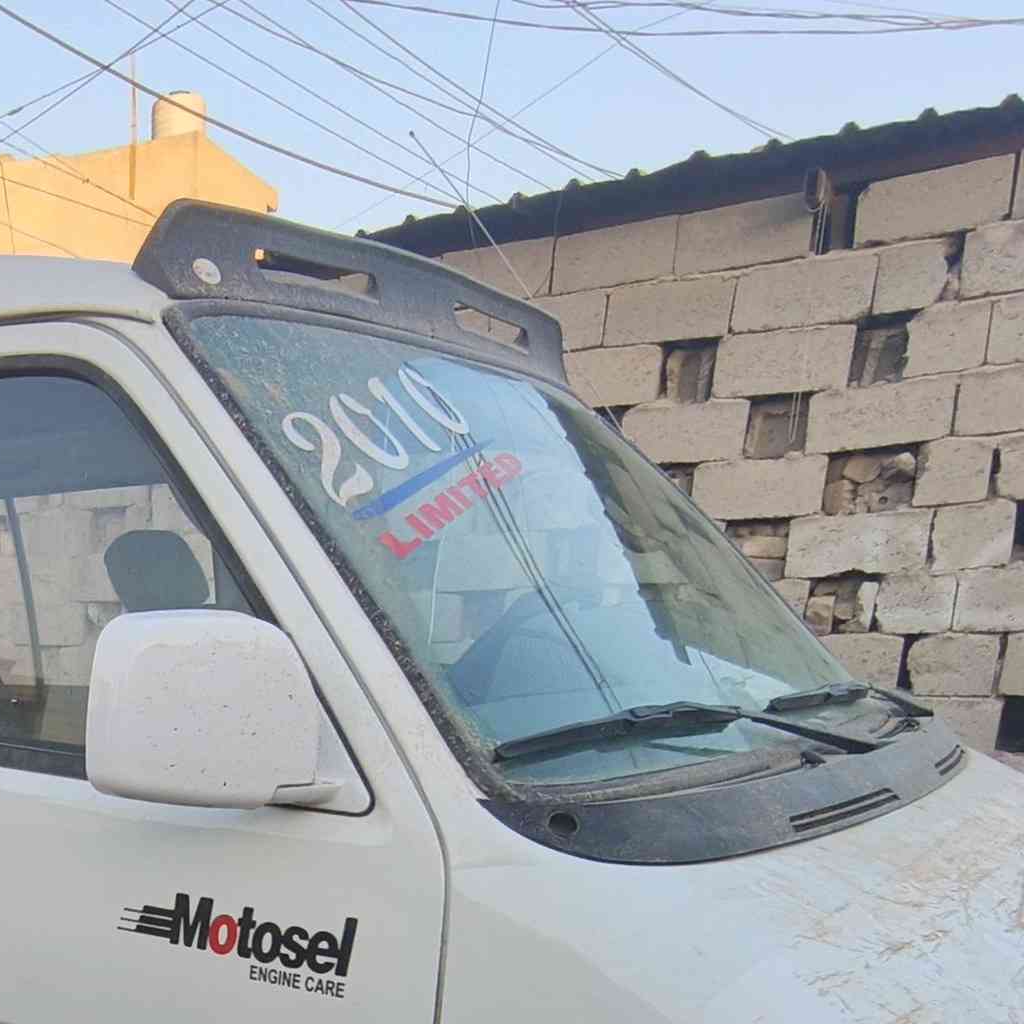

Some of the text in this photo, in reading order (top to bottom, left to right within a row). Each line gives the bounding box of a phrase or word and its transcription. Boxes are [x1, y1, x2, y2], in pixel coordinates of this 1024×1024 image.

[281, 361, 470, 507] 2010
[378, 452, 524, 560] LIMITED
[169, 892, 358, 978] Motosel
[248, 964, 345, 999] ENGINE CARE
